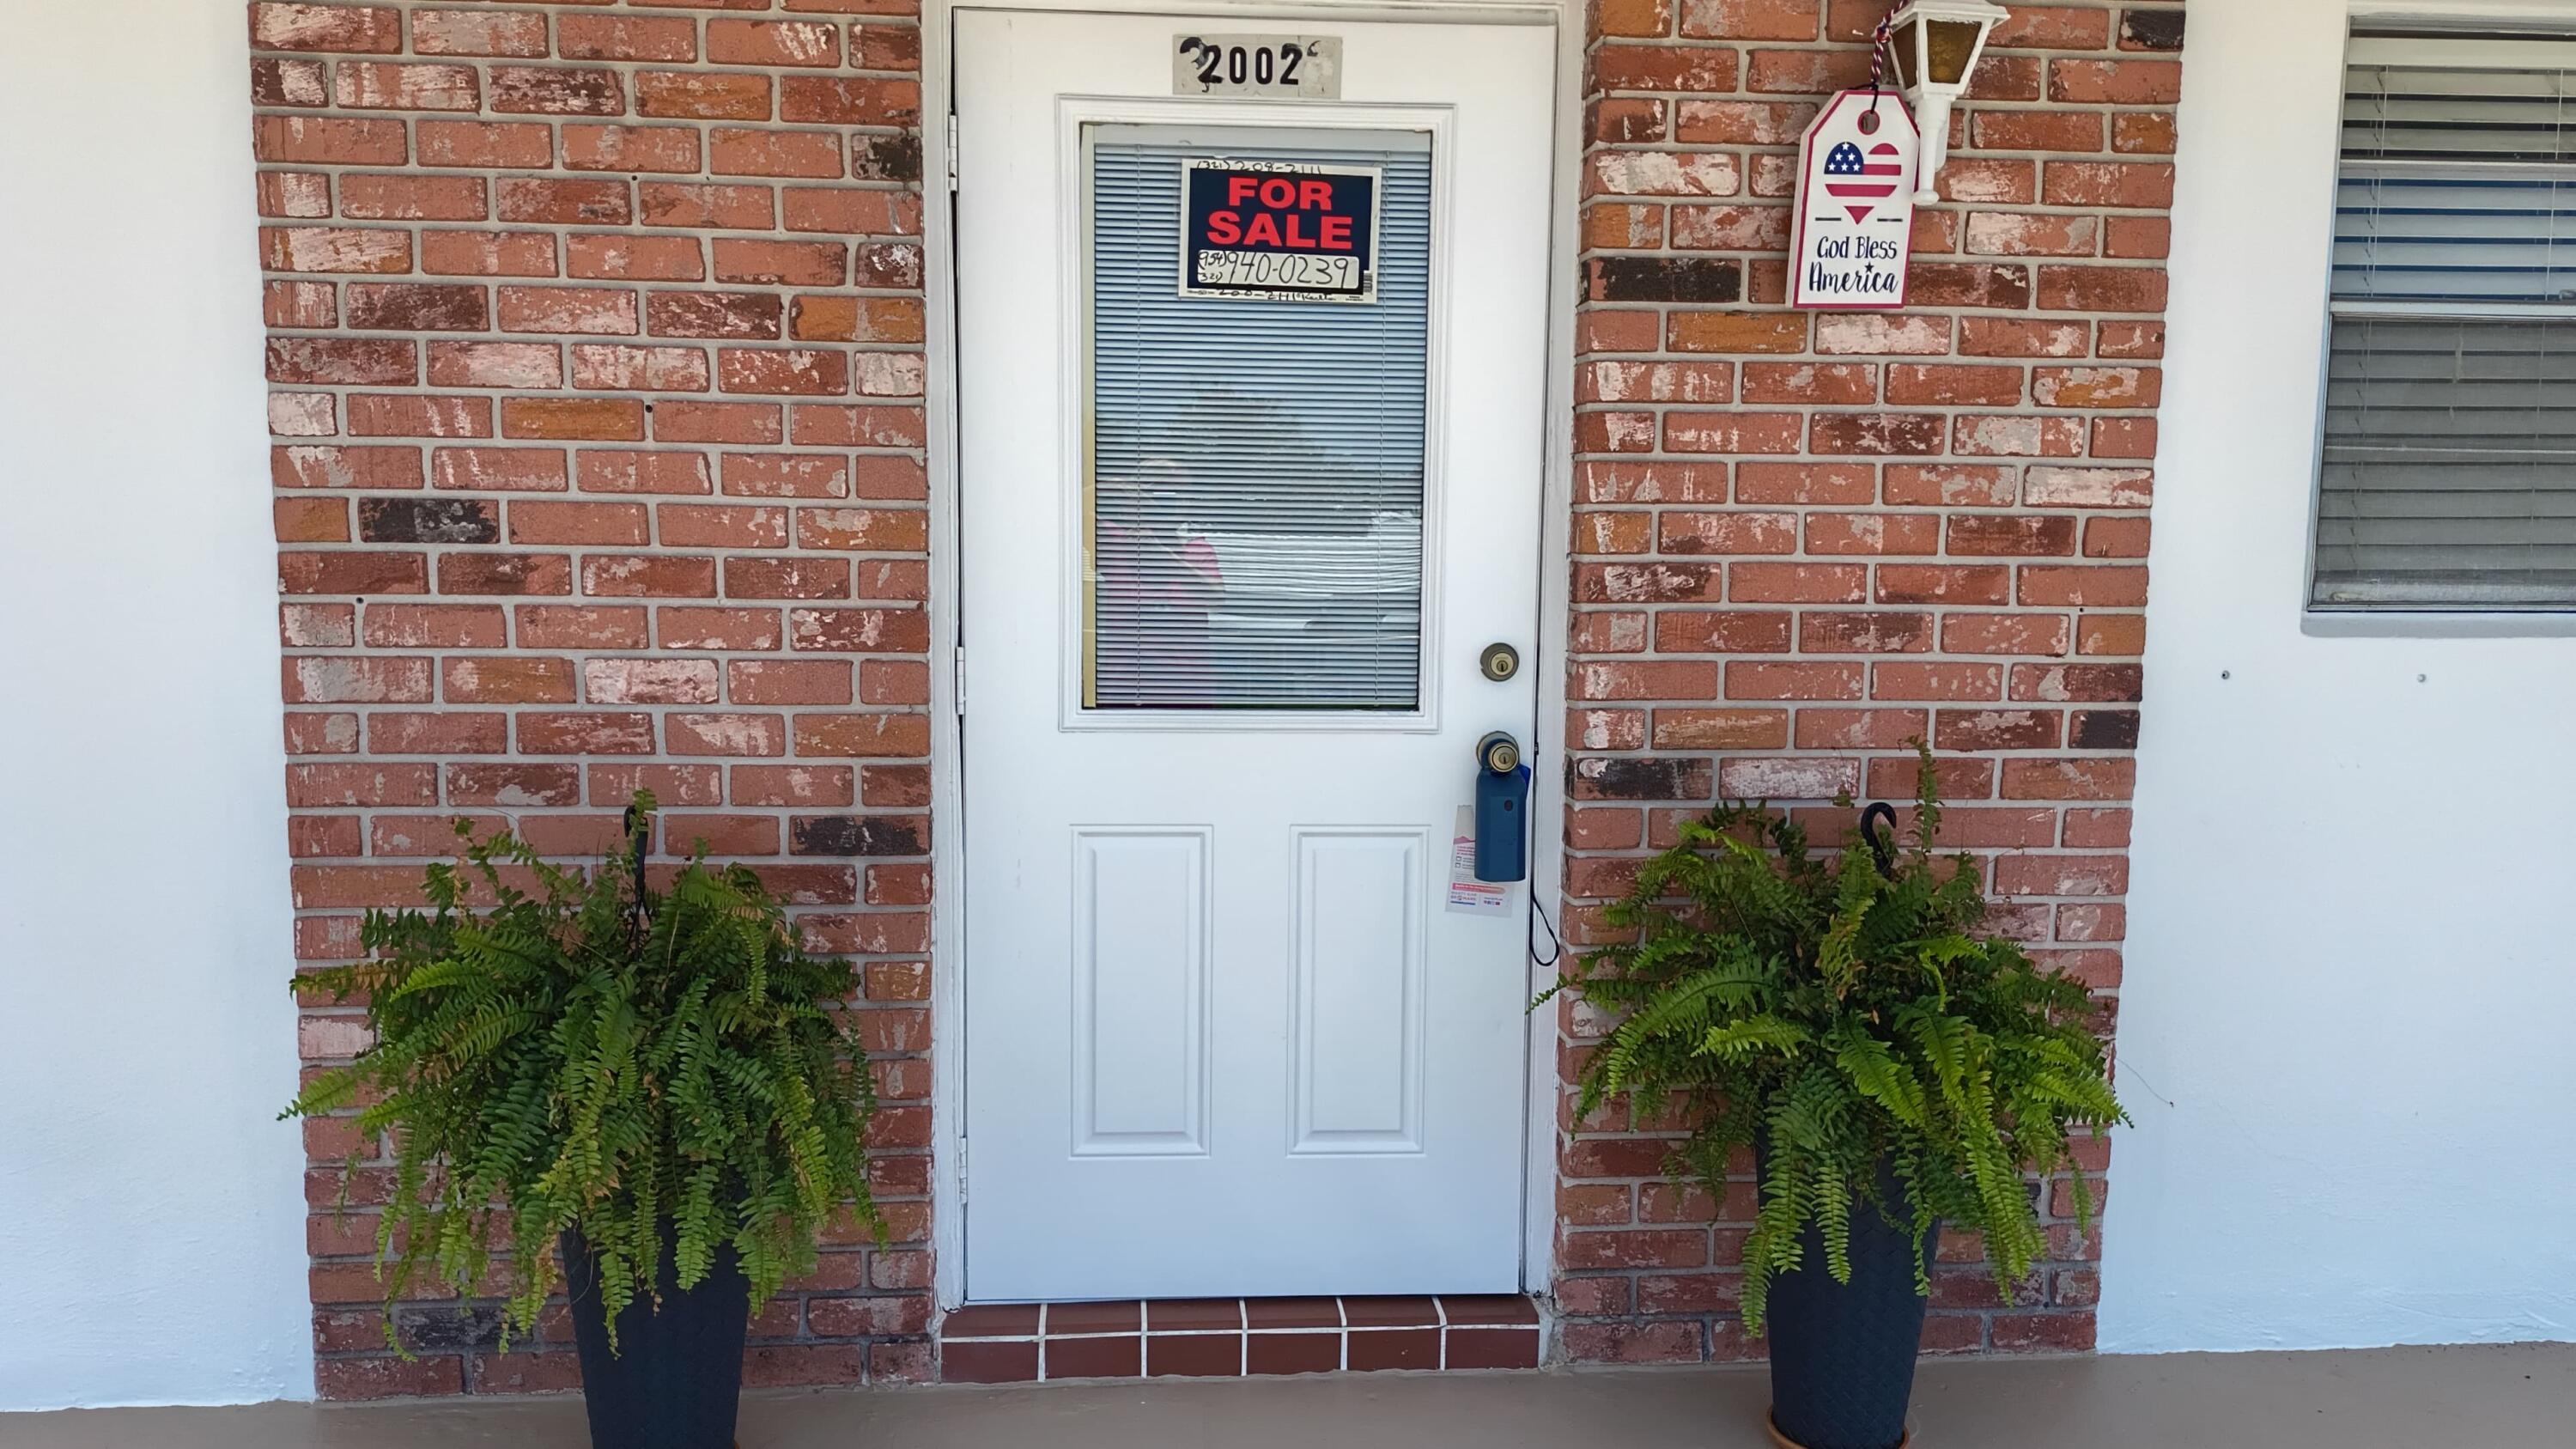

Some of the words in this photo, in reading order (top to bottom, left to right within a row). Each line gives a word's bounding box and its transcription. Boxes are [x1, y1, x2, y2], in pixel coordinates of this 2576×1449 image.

[1197, 43, 1303, 85] 2002
[1228, 177, 1333, 210] FOR
[1206, 211, 1352, 249] SALE
[1817, 236, 1850, 259] God
[1855, 236, 1897, 259] Bless
[1809, 261, 1899, 293] America
